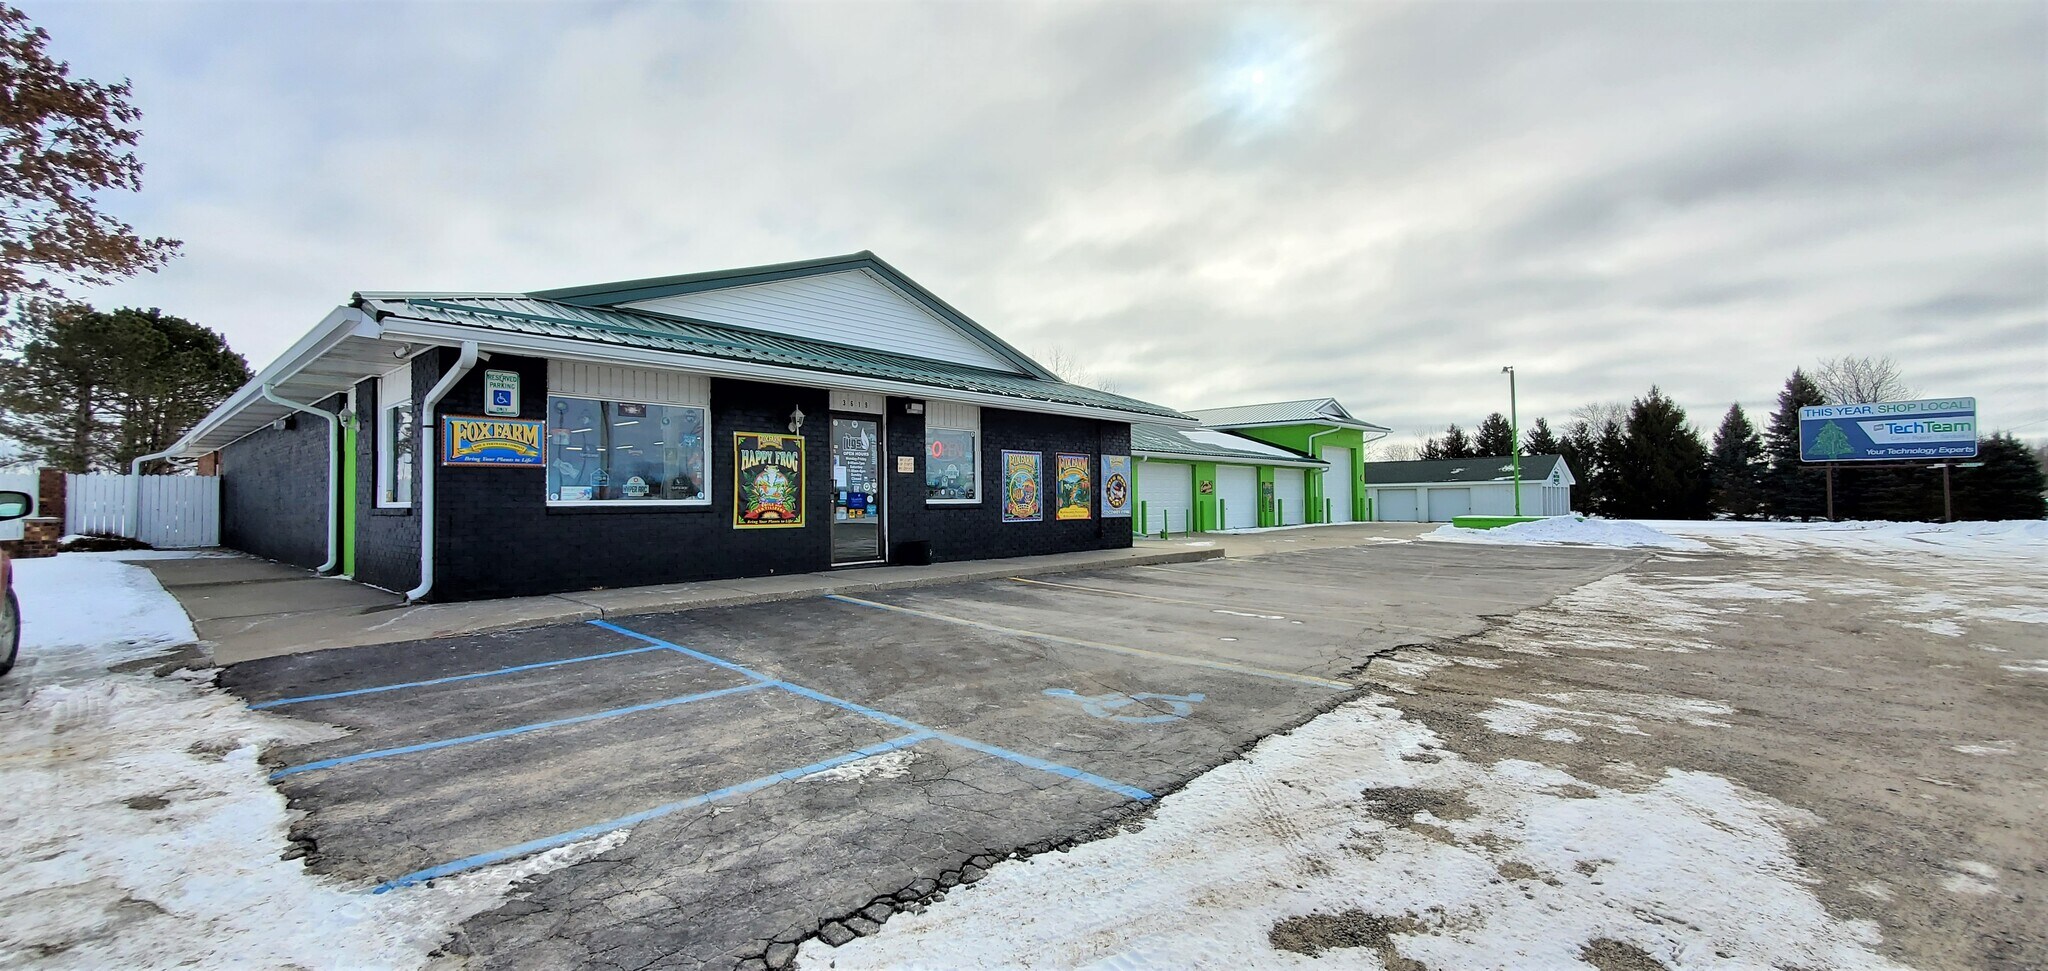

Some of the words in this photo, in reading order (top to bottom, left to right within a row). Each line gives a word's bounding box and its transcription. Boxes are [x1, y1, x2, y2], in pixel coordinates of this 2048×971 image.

[487, 373, 517, 383] RESERVED
[489, 381, 515, 390] PARKING
[1804, 408, 1832, 417] THIS
[1836, 405, 1874, 415] YEAR,
[1877, 402, 1916, 414] SHOP
[1920, 400, 1972, 411] LOCAL!
[1866, 448, 1886, 456] Your
[1887, 446, 1937, 457] Technology
[1938, 445, 1974, 455] Experts
[741, 449, 773, 470] HAPPY
[774, 451, 799, 472] FROG
